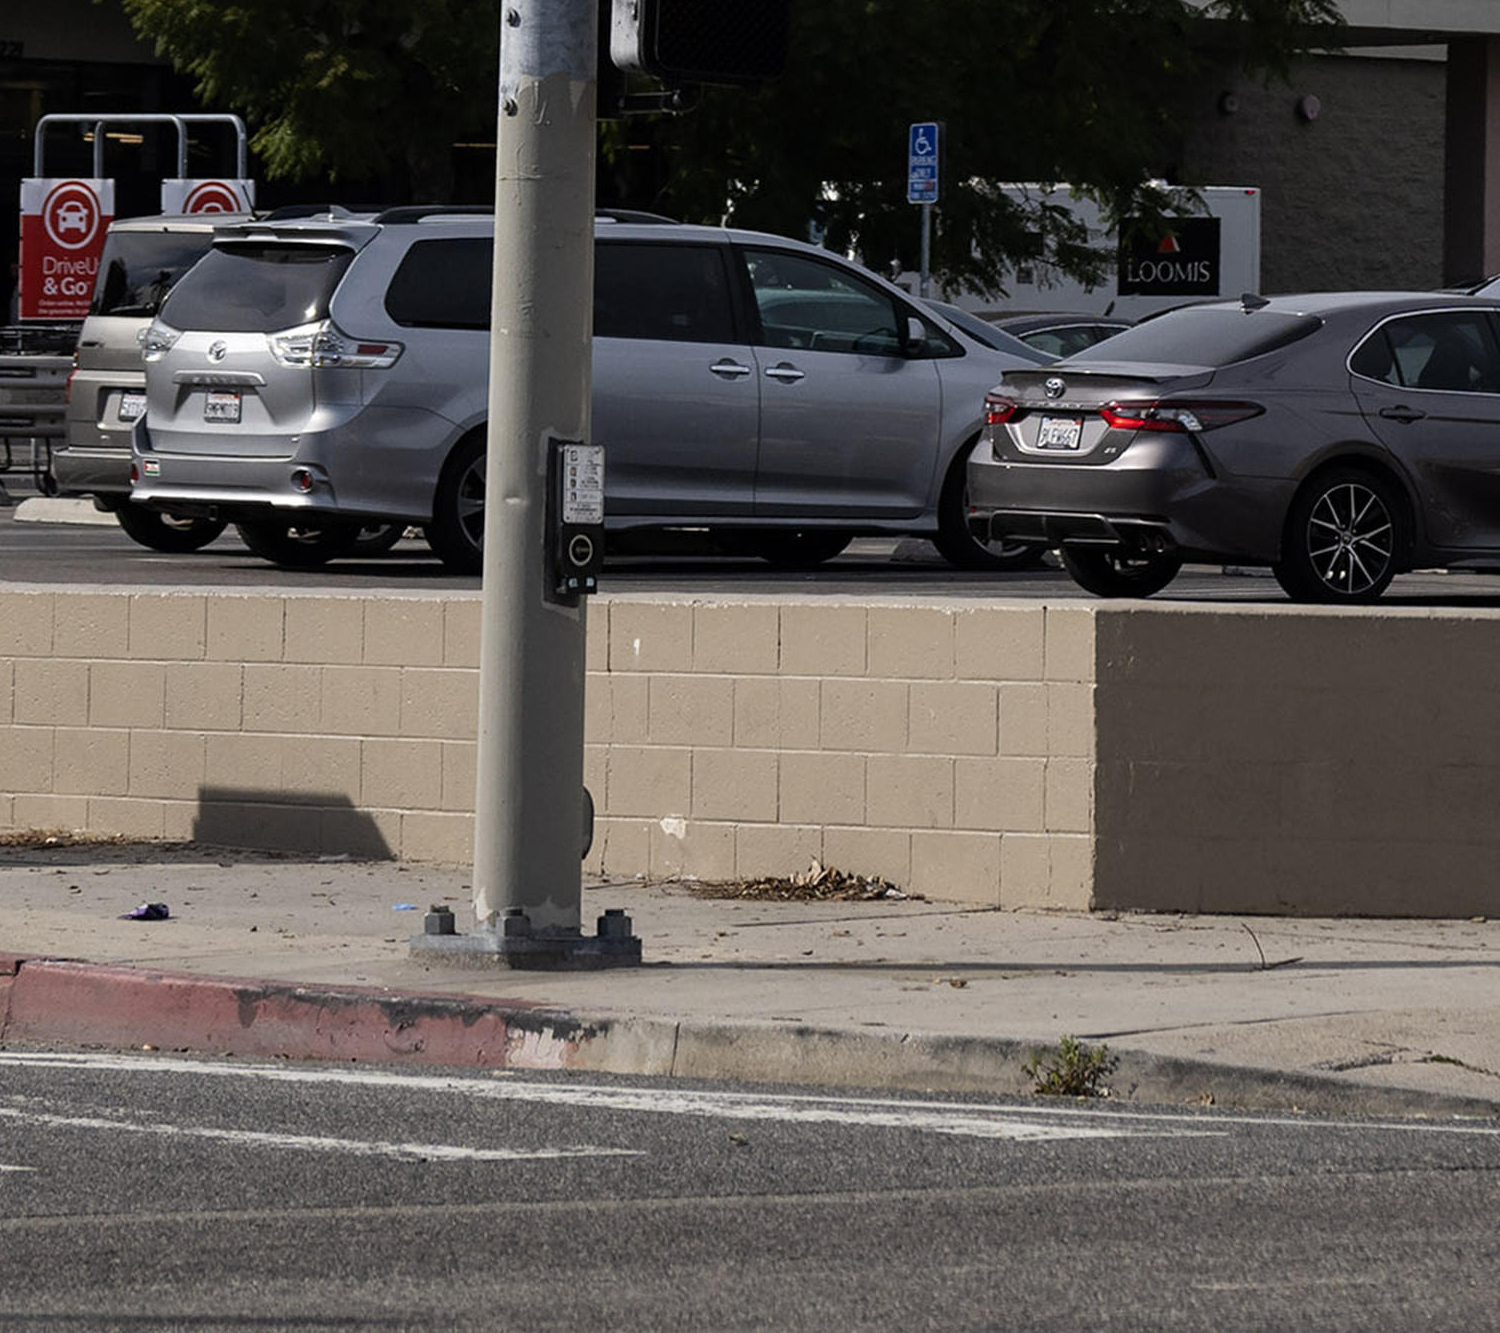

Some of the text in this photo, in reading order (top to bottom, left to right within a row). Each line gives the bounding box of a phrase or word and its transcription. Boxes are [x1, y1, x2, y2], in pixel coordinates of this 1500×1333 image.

[42, 255, 100, 275] DriveU
[1127, 259, 1211, 283] LOOMIS
[60, 276, 88, 296] Go
